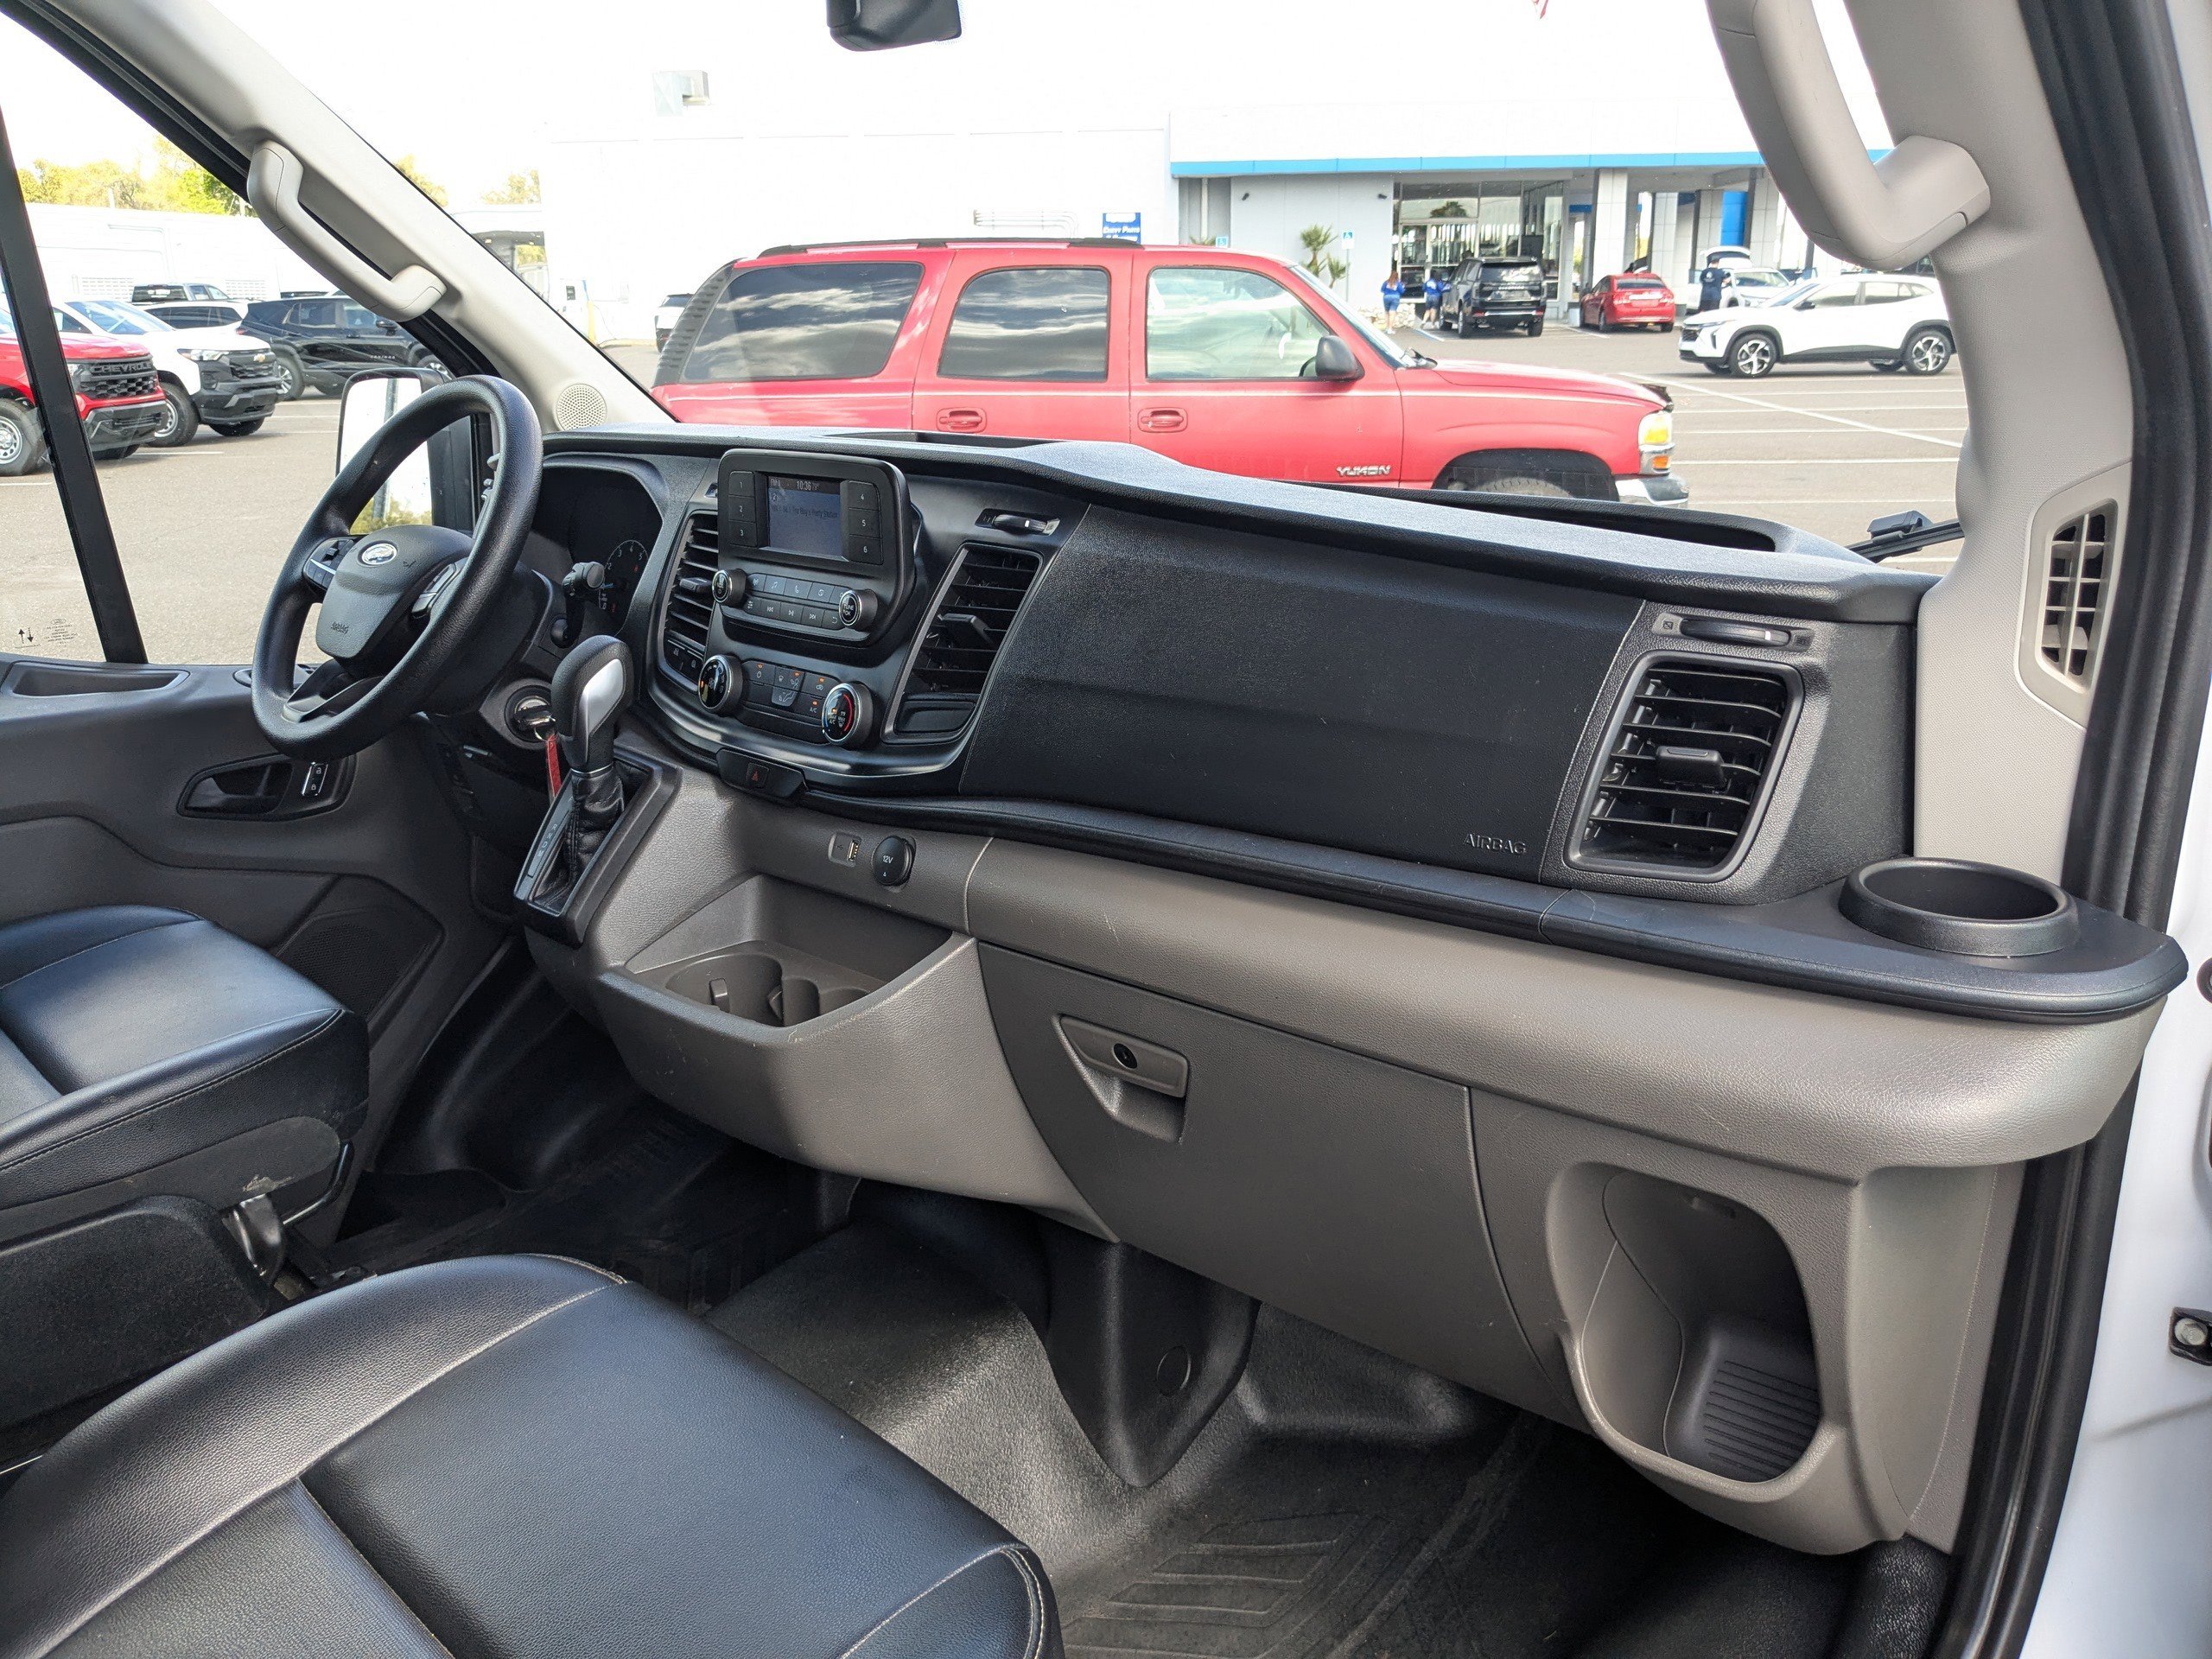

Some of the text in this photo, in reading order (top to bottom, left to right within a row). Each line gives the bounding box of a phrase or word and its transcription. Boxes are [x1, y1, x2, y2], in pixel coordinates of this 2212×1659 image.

[1336, 464, 1391, 477] YUKON
[860, 493, 865, 502] 4
[739, 505, 743, 513] 2
[740, 528, 744, 537] 3
[862, 545, 868, 554] 6
[1463, 832, 1529, 856] AIRBAG
[882, 855, 893, 864] 12V
